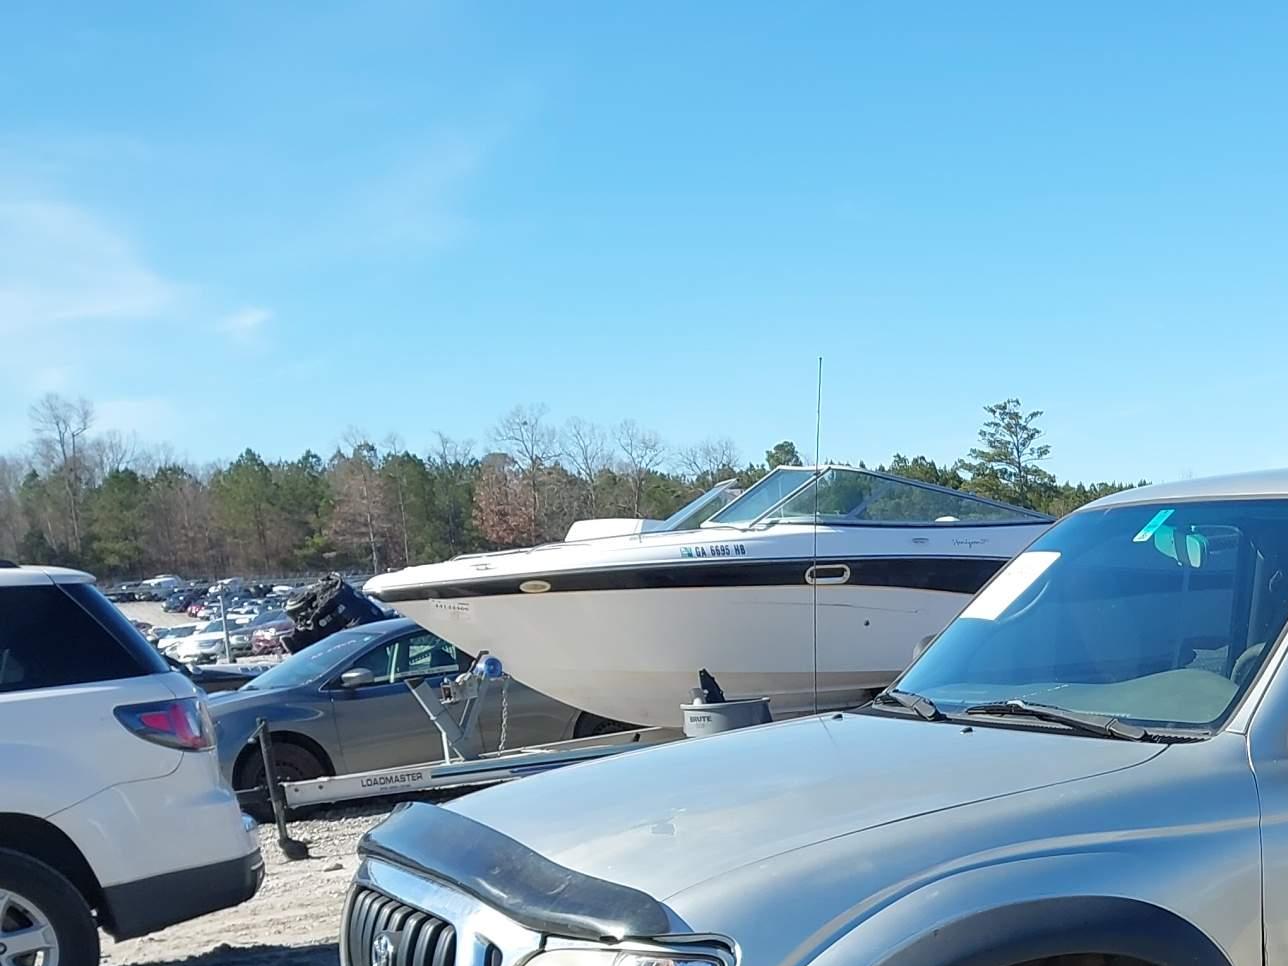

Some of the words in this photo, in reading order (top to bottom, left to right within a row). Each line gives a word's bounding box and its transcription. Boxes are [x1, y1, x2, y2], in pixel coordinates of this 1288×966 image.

[695, 546, 706, 557] GA
[710, 545, 730, 556] 6695
[361, 772, 423, 787] LOADMASTER
